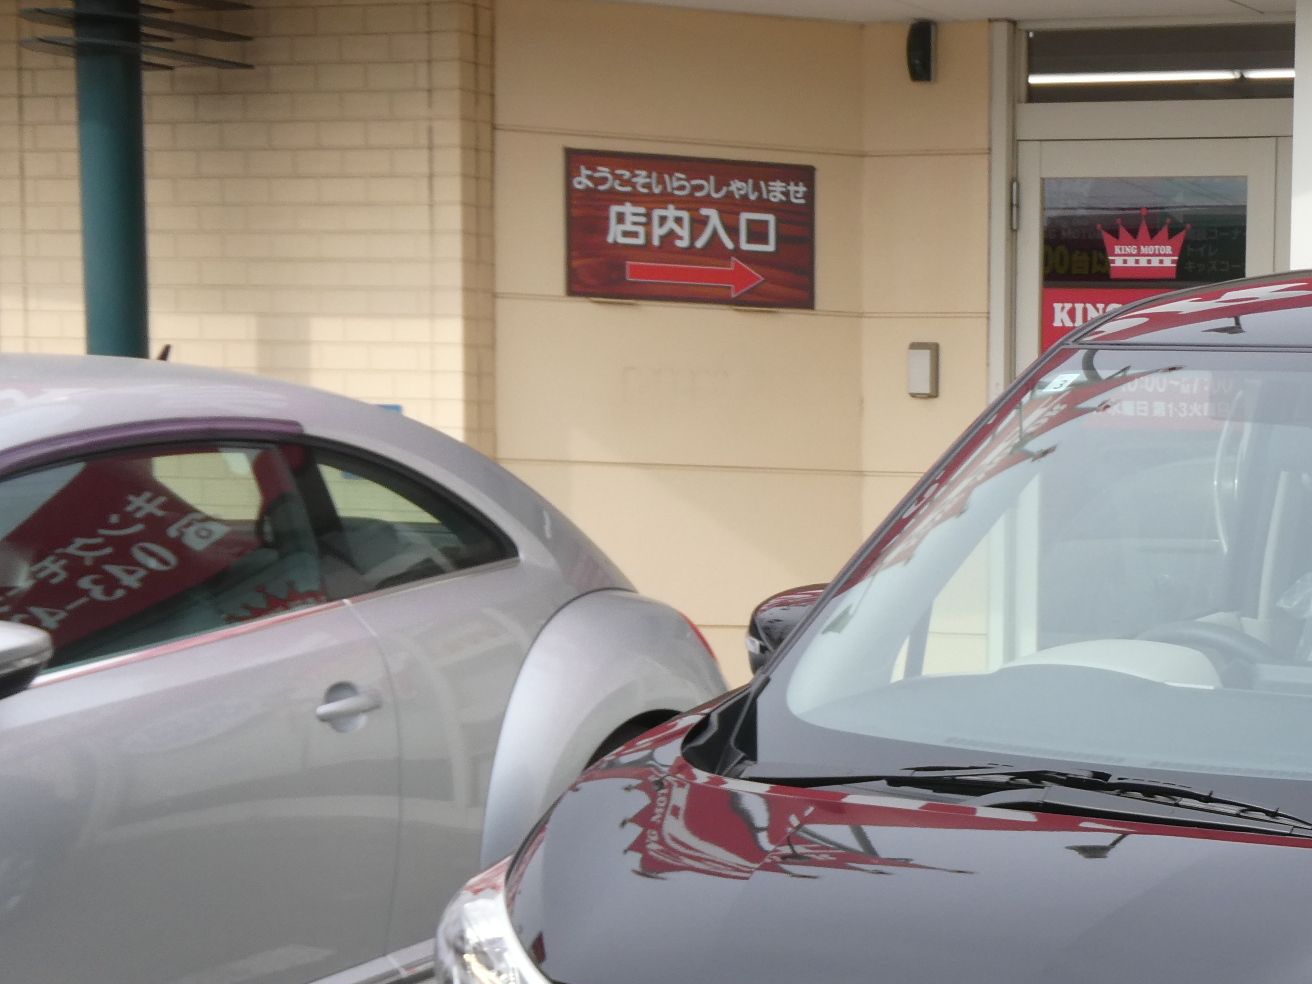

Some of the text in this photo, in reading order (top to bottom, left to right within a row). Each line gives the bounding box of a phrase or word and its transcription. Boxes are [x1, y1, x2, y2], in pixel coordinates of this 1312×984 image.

[572, 165, 807, 203] ようこそいらっしゃいませ
[606, 202, 778, 253] 店内入口
[1114, 244, 1173, 255] KING MOTOR
[1052, 302, 1122, 327] KIN
